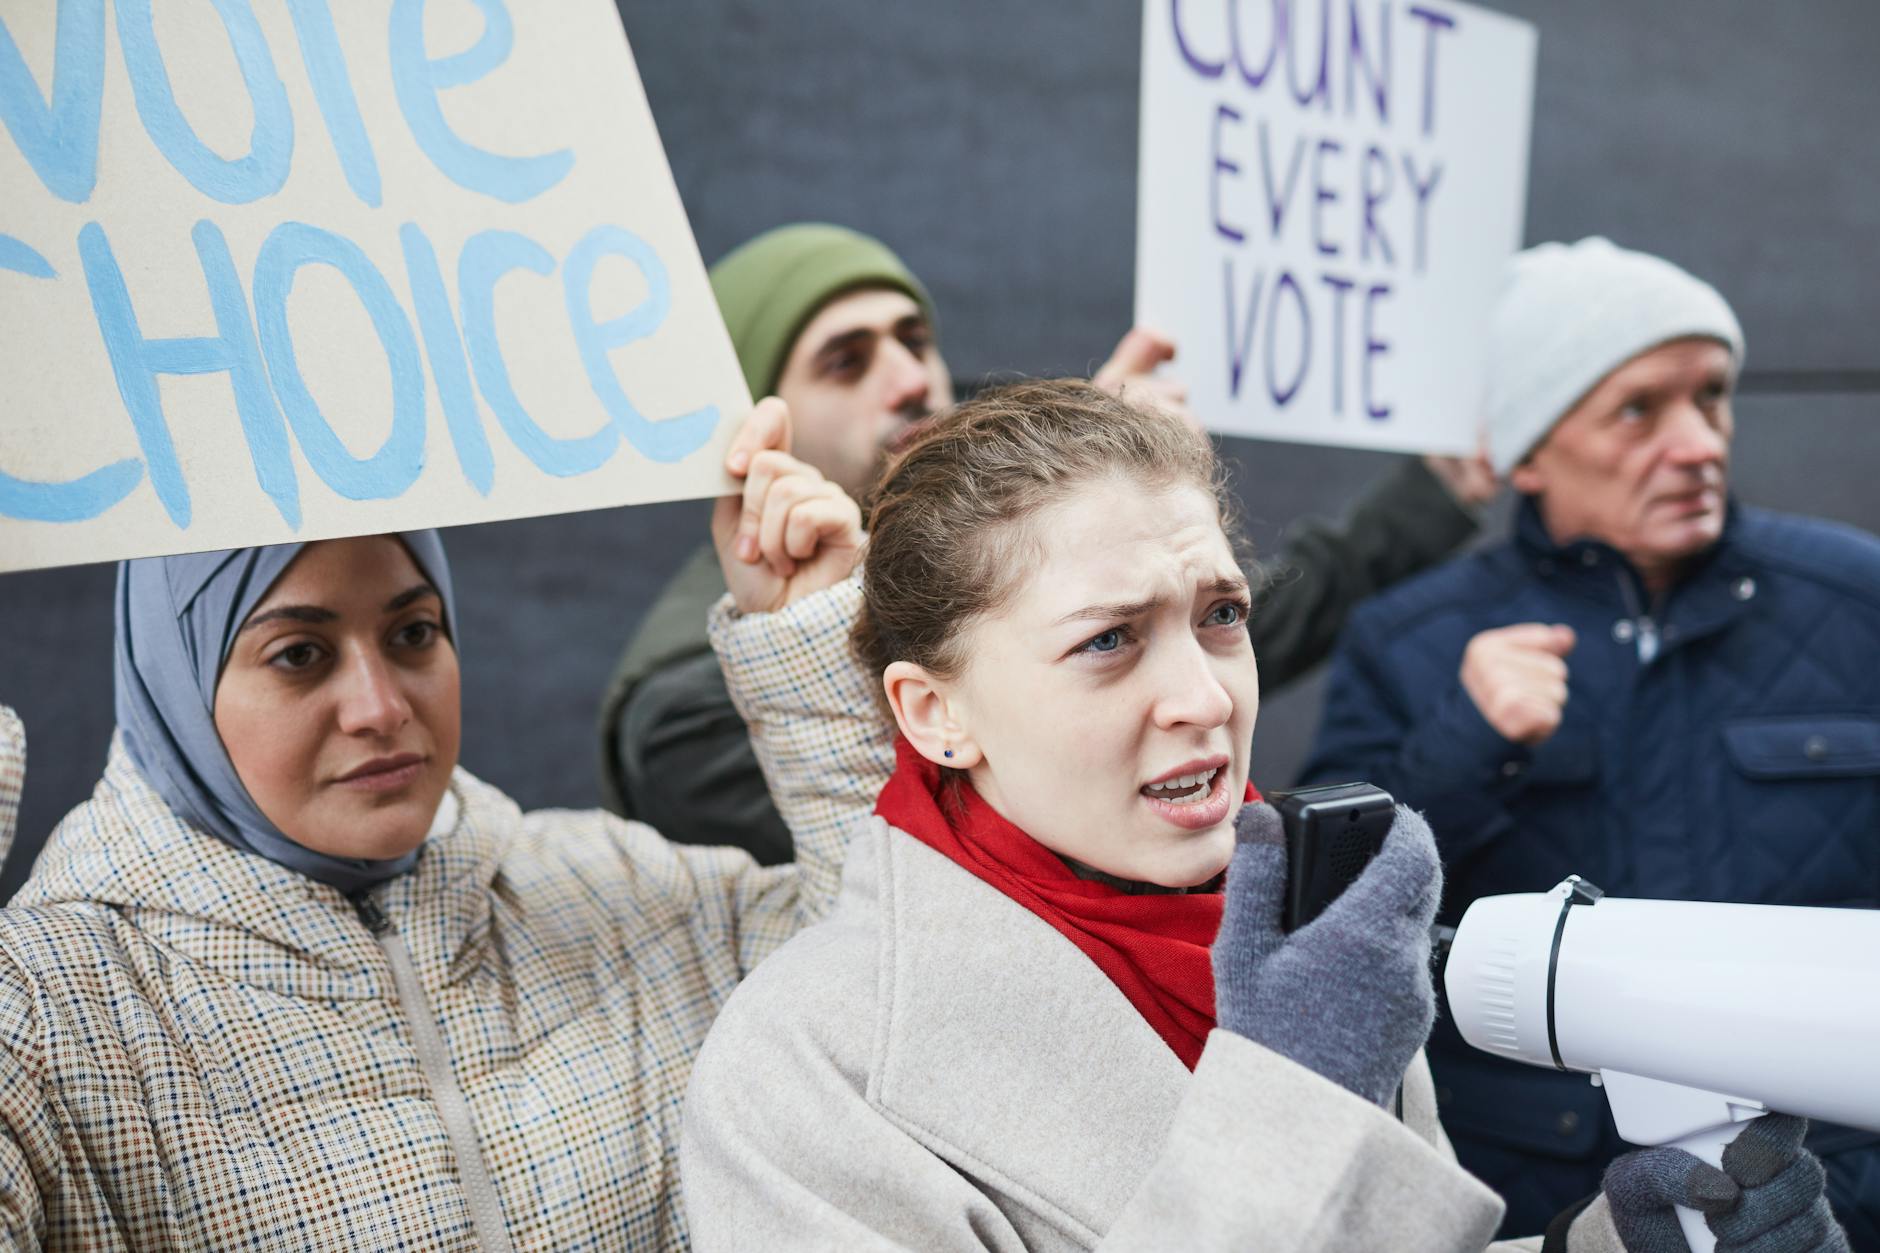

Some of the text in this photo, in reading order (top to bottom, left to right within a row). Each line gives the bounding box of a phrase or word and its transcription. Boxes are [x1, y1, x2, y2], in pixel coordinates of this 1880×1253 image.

[1171, 0, 1456, 136] COUNT
[1211, 103, 1445, 277] EVERY
[1223, 258, 1391, 420] VOTE
